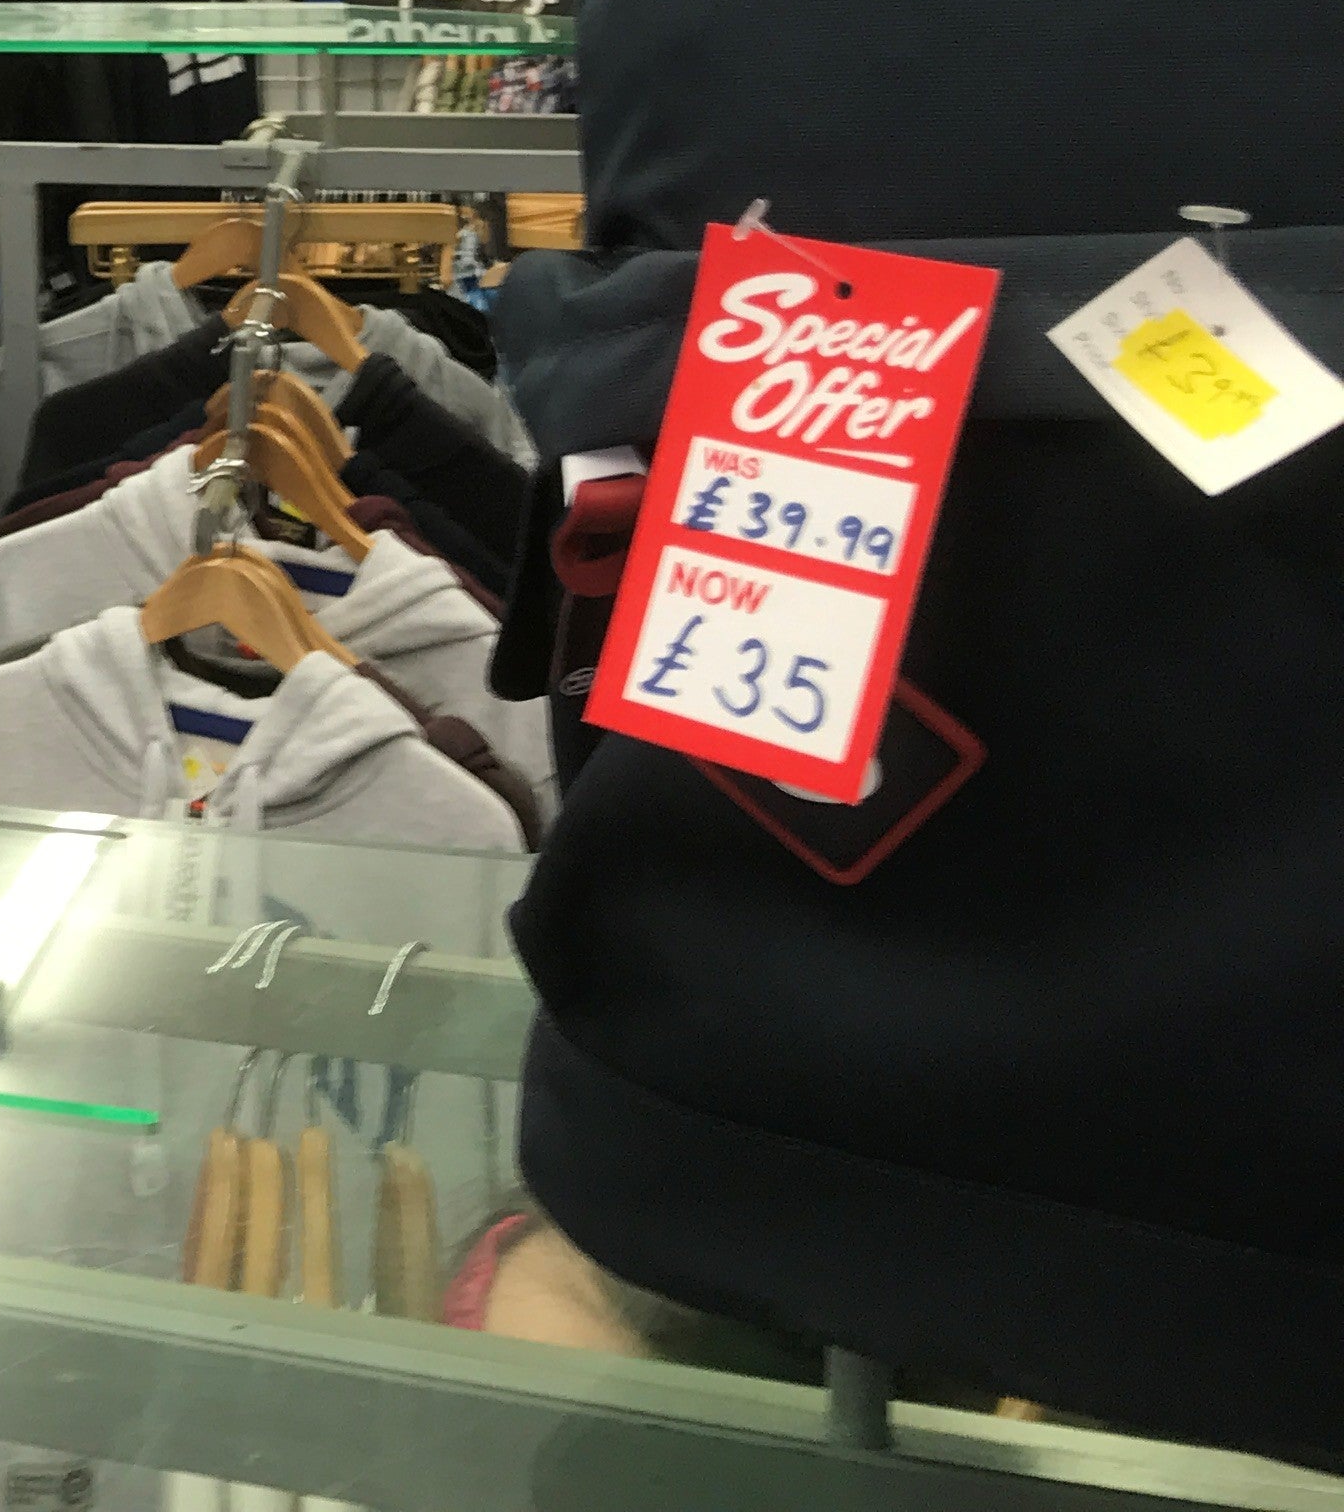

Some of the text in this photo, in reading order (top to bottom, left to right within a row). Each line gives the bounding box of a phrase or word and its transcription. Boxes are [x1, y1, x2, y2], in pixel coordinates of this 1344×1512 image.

[699, 272, 981, 366] Special
[731, 361, 934, 446] Offer
[703, 446, 764, 479] WAS
[666, 561, 773, 615] NOW
